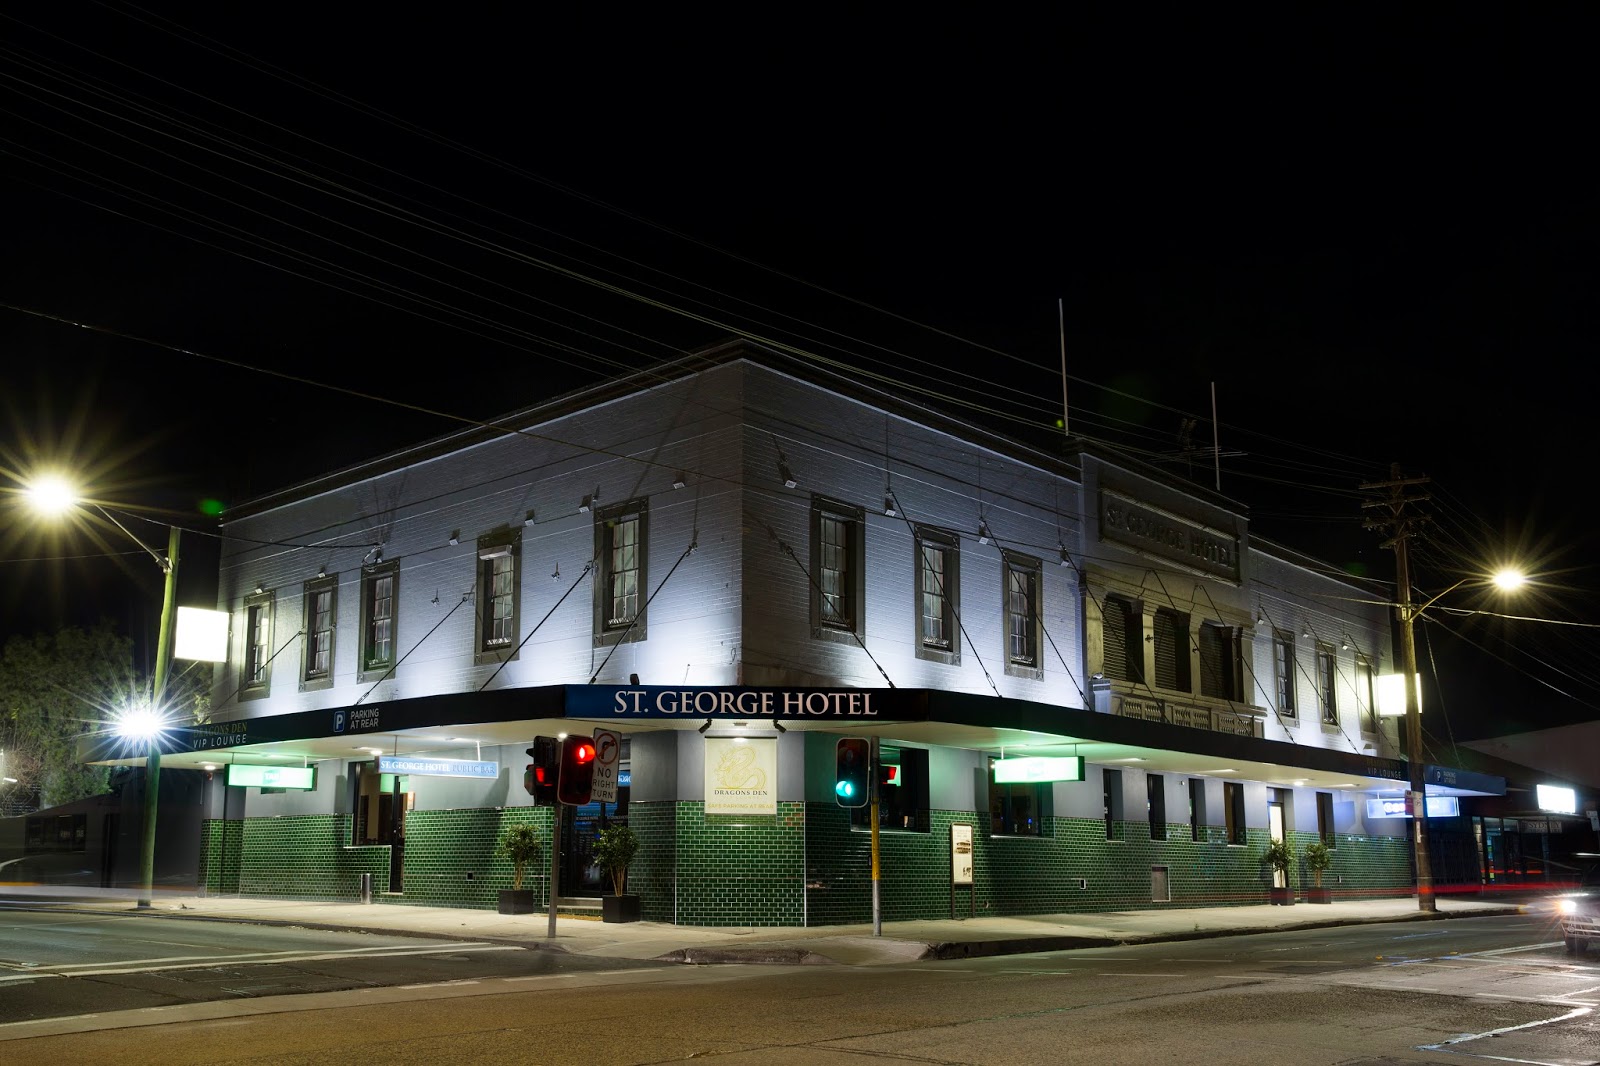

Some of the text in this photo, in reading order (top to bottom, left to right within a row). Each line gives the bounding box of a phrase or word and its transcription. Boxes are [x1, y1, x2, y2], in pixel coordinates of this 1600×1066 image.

[614, 690, 878, 716] ST. GEORGE HOTEL
[350, 708, 379, 720] PARKING
[350, 718, 379, 729] AT REAR
[193, 722, 247, 738] DRAGONS DEN
[193, 733, 247, 749] VIP LOUNGE
[380, 760, 495, 774] ST. GEORGE HOTEL PUBLIC BAR
[597, 767, 612, 778] NO
[1379, 768, 1402, 779] LOUNGE
[593, 778, 615, 789] RIGHT
[593, 788, 613, 799] TURN
